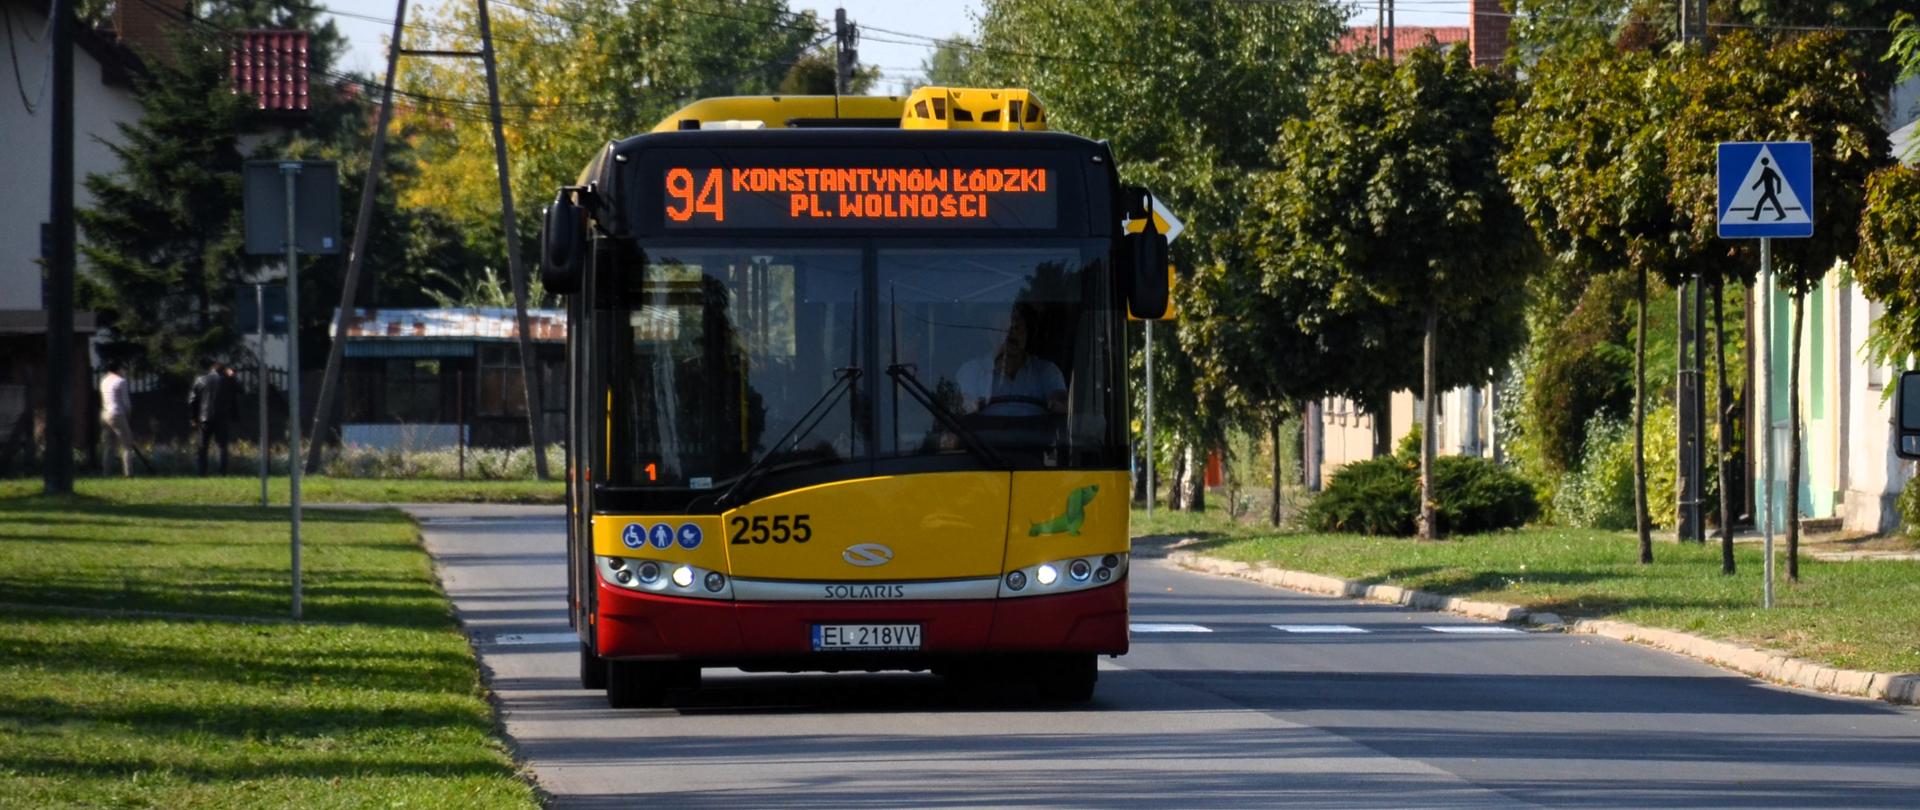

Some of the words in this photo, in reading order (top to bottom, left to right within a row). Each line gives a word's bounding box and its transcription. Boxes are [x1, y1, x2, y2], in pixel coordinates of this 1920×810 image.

[732, 168, 948, 192] KONSTANTYNÓW
[953, 168, 1046, 192] ŁÓDZKI
[666, 168, 724, 221] 94
[790, 194, 832, 218] PL.
[839, 194, 987, 218] WOLNOŚCI
[644, 463, 657, 481] 1
[731, 514, 812, 544] 2555
[825, 585, 904, 599] SOLARIS
[824, 627, 850, 645] EL
[858, 627, 917, 645] 218VV
